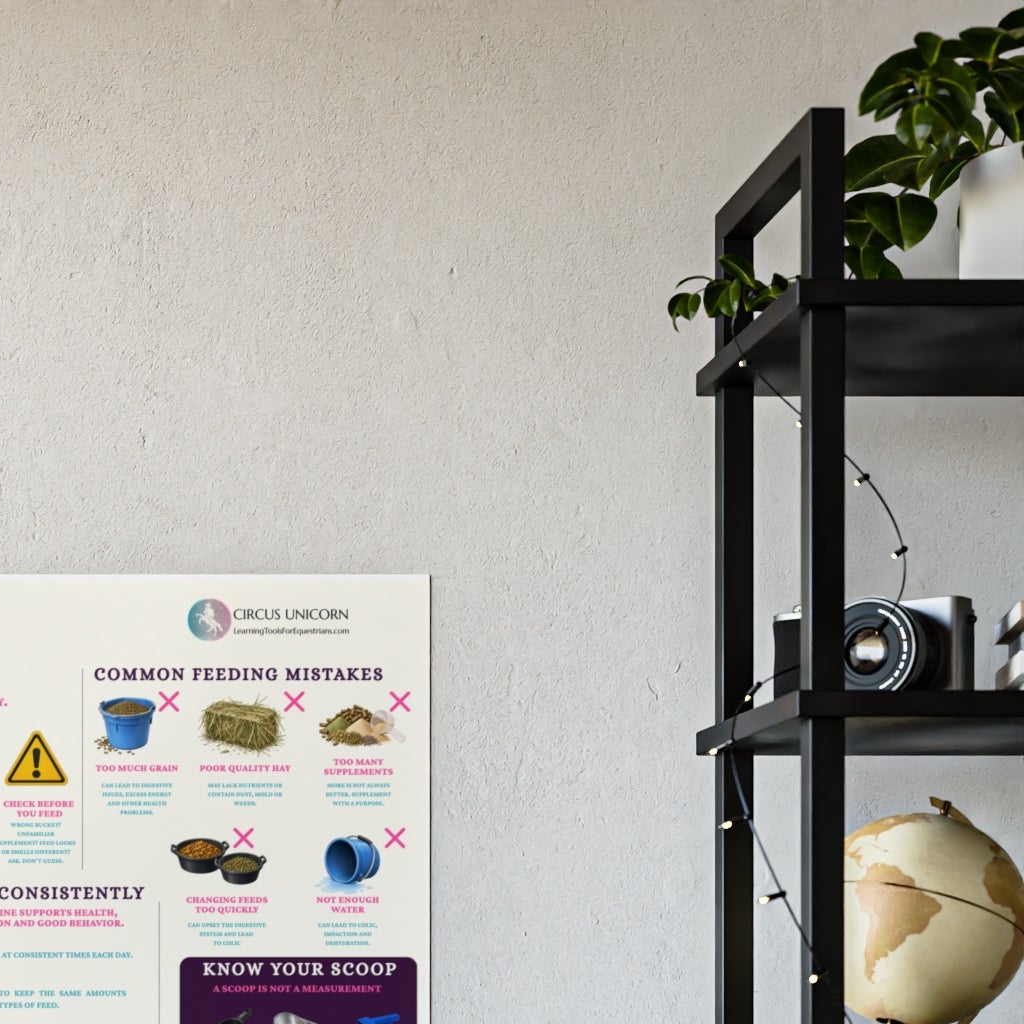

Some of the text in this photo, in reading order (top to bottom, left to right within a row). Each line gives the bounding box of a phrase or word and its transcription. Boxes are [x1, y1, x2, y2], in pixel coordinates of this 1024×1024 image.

[233, 608, 349, 620] CIRCUS UNICORN
[233, 627, 350, 636] LearningToolsForEquestrians.com
[94, 668, 382, 681] COMMON FEEDING MISTAKES
[228, 765, 270, 773] QUALITY
[324, 768, 393, 776] SUPPLEMENTS
[38, 800, 74, 808] BEFORE
[17, 810, 36, 818] YOU
[186, 896, 268, 904] CHANGING FEEDS
[316, 896, 379, 904] NOT ENOUGH
[20, 909, 72, 917] SUPPORTS
[74, 909, 118, 918] HEALTH,
[195, 906, 258, 915] TOO QUICKLY
[203, 962, 396, 976] KNOW YOUR SCOOP
[213, 985, 381, 993] A SCOOP IS NOT A MEASUREMENT
